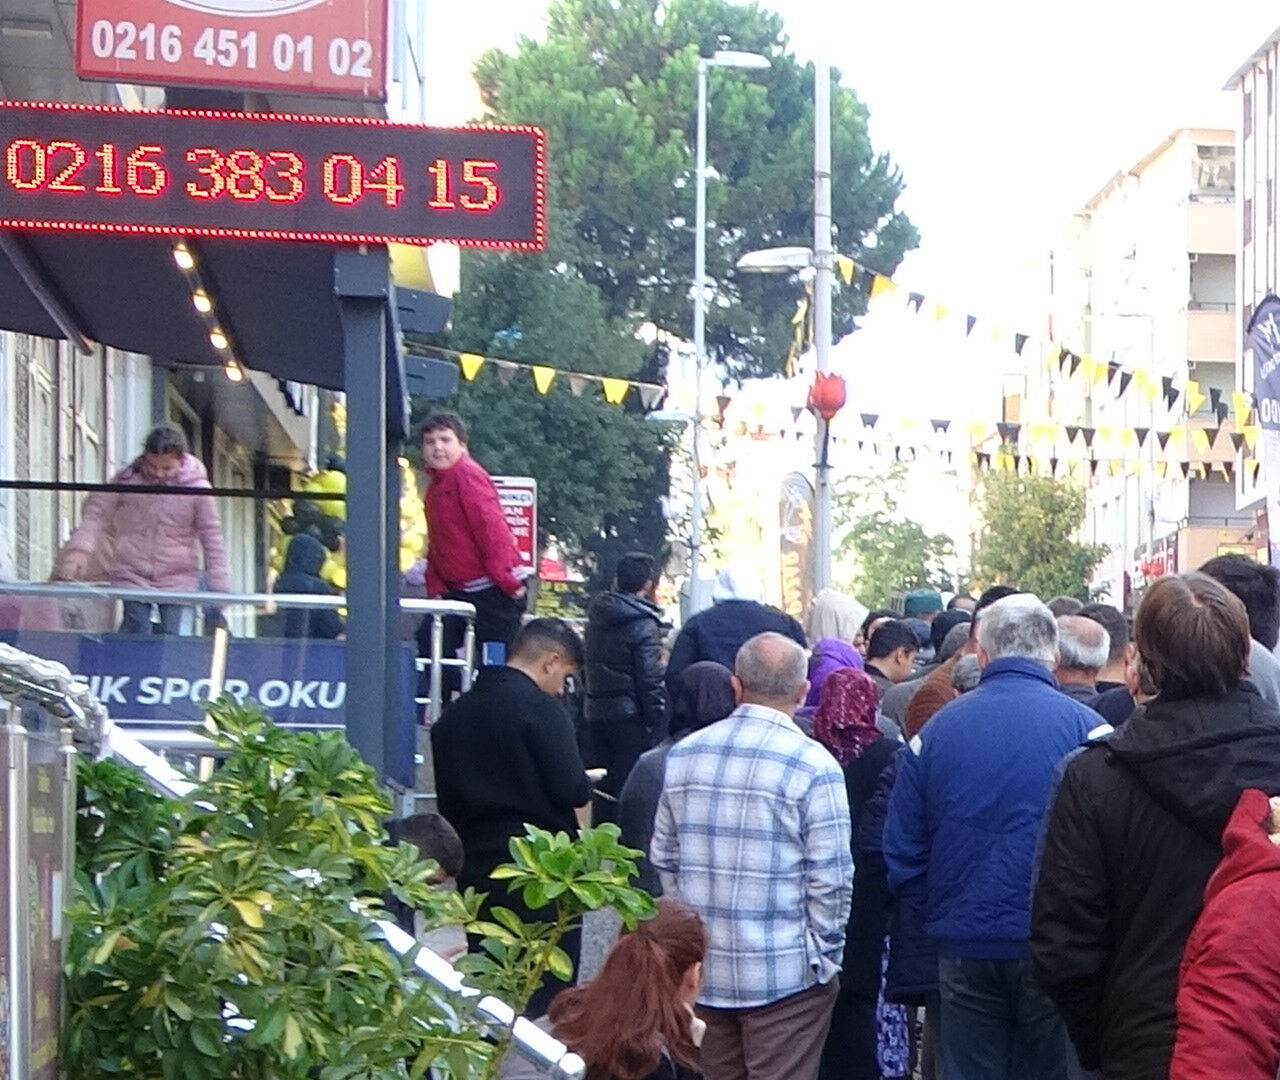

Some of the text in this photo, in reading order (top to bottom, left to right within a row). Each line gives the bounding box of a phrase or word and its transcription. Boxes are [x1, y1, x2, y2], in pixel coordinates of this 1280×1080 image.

[92, 20, 373, 77] 0216 451 01 02
[6, 139, 500, 212] 0216 383 04 15
[74, 674, 348, 710] IK SPOR OKU
